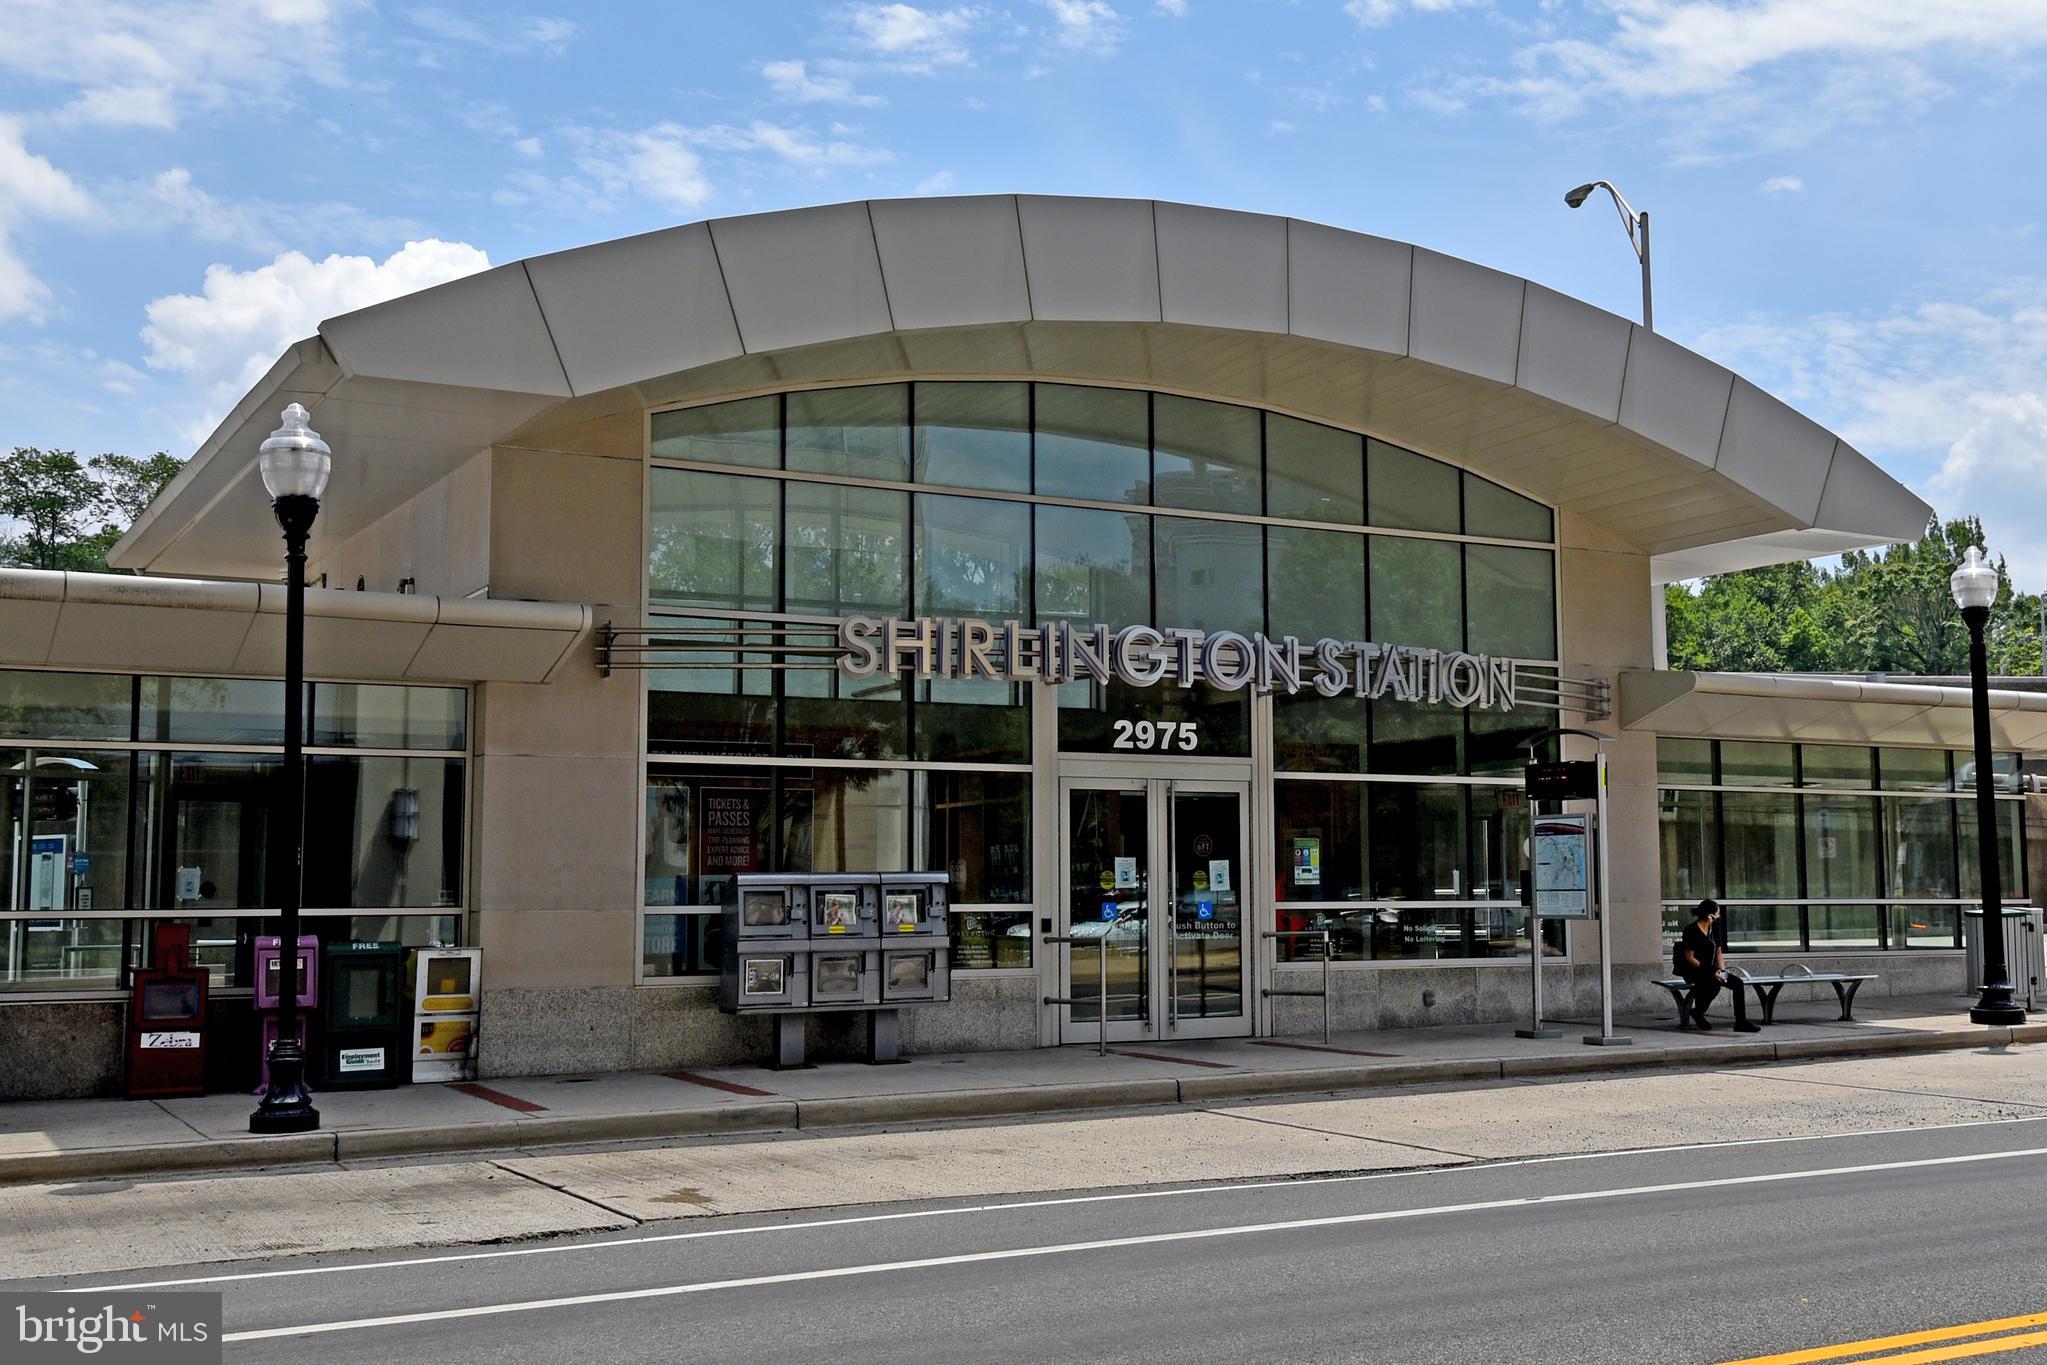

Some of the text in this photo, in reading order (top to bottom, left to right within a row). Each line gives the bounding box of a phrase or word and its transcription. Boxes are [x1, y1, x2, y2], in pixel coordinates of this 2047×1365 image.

[836, 614, 1516, 713] SHIRLINGTON STATION
[1113, 719, 1198, 751] 2975
[708, 798, 750, 810] TICKETS &
[708, 811, 750, 826] PASSES
[707, 855, 750, 867] AND MORE!
[1194, 921, 1224, 930] Button
[1227, 921, 1236, 929] to
[1403, 924, 1413, 932] No
[1213, 931, 1234, 940] Door
[352, 942, 380, 950] FREE
